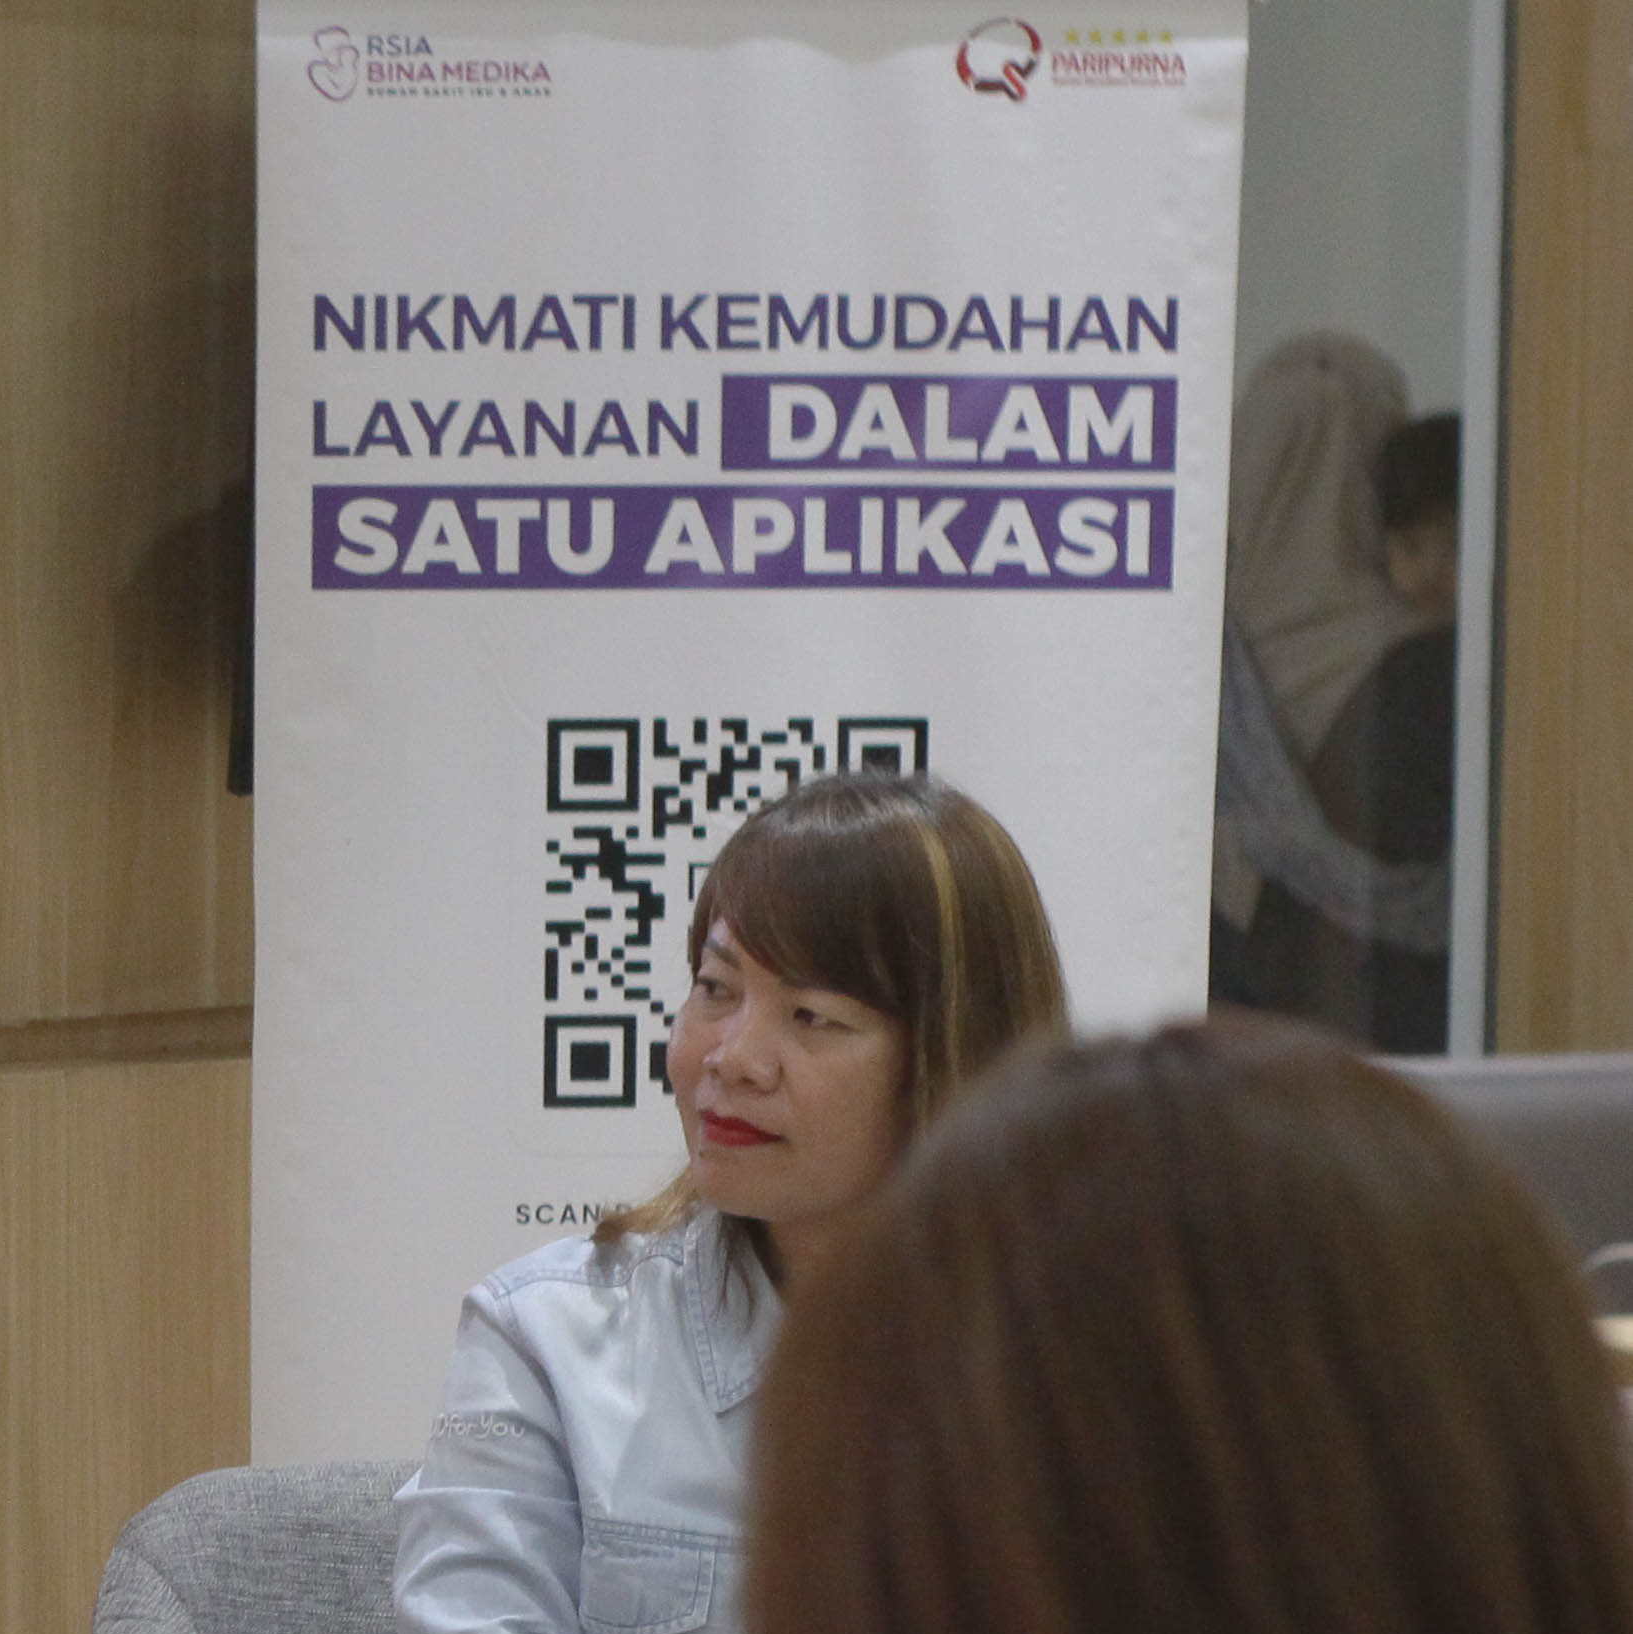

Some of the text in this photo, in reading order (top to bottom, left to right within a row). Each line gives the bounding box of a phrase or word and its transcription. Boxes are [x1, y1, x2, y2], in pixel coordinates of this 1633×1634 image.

[366, 34, 434, 57] RSIA
[366, 61, 552, 83] BINA MEDIKA
[1051, 50, 1188, 76] PARIPURNA
[312, 294, 1179, 353] NIKMATI KEMUDAHAN
[312, 385, 1154, 463] LAYANAN DALAM
[332, 497, 1150, 578] SATU APLIKASI
[515, 1203, 601, 1225] SCAN
